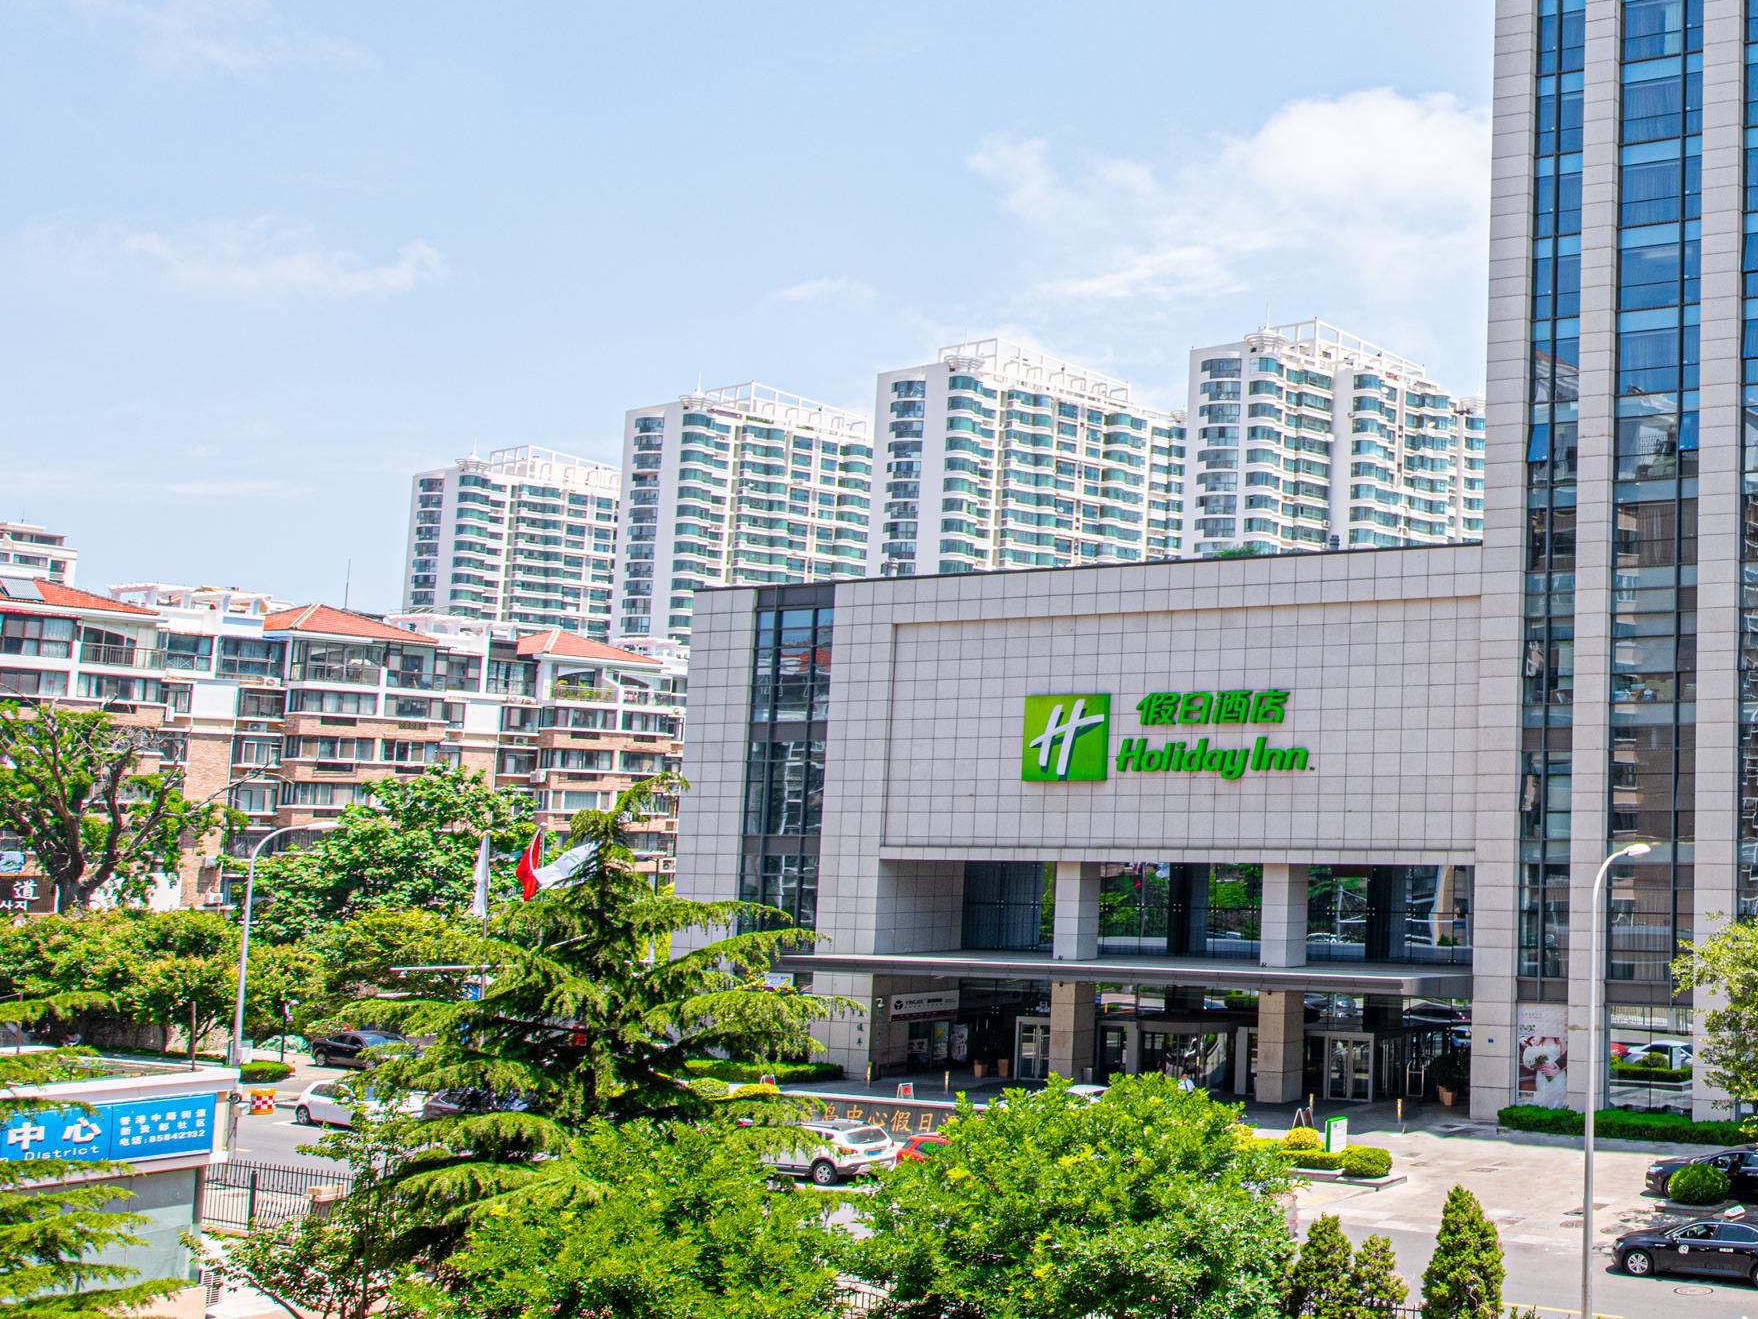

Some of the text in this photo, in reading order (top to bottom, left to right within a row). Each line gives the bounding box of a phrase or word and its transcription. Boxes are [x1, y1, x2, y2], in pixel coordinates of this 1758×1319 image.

[1136, 689, 1291, 725] 假日酒店
[1116, 736, 1310, 780] Holiday Inn
[7, 1117, 102, 1150] 中心
[24, 1145, 100, 1162] District
